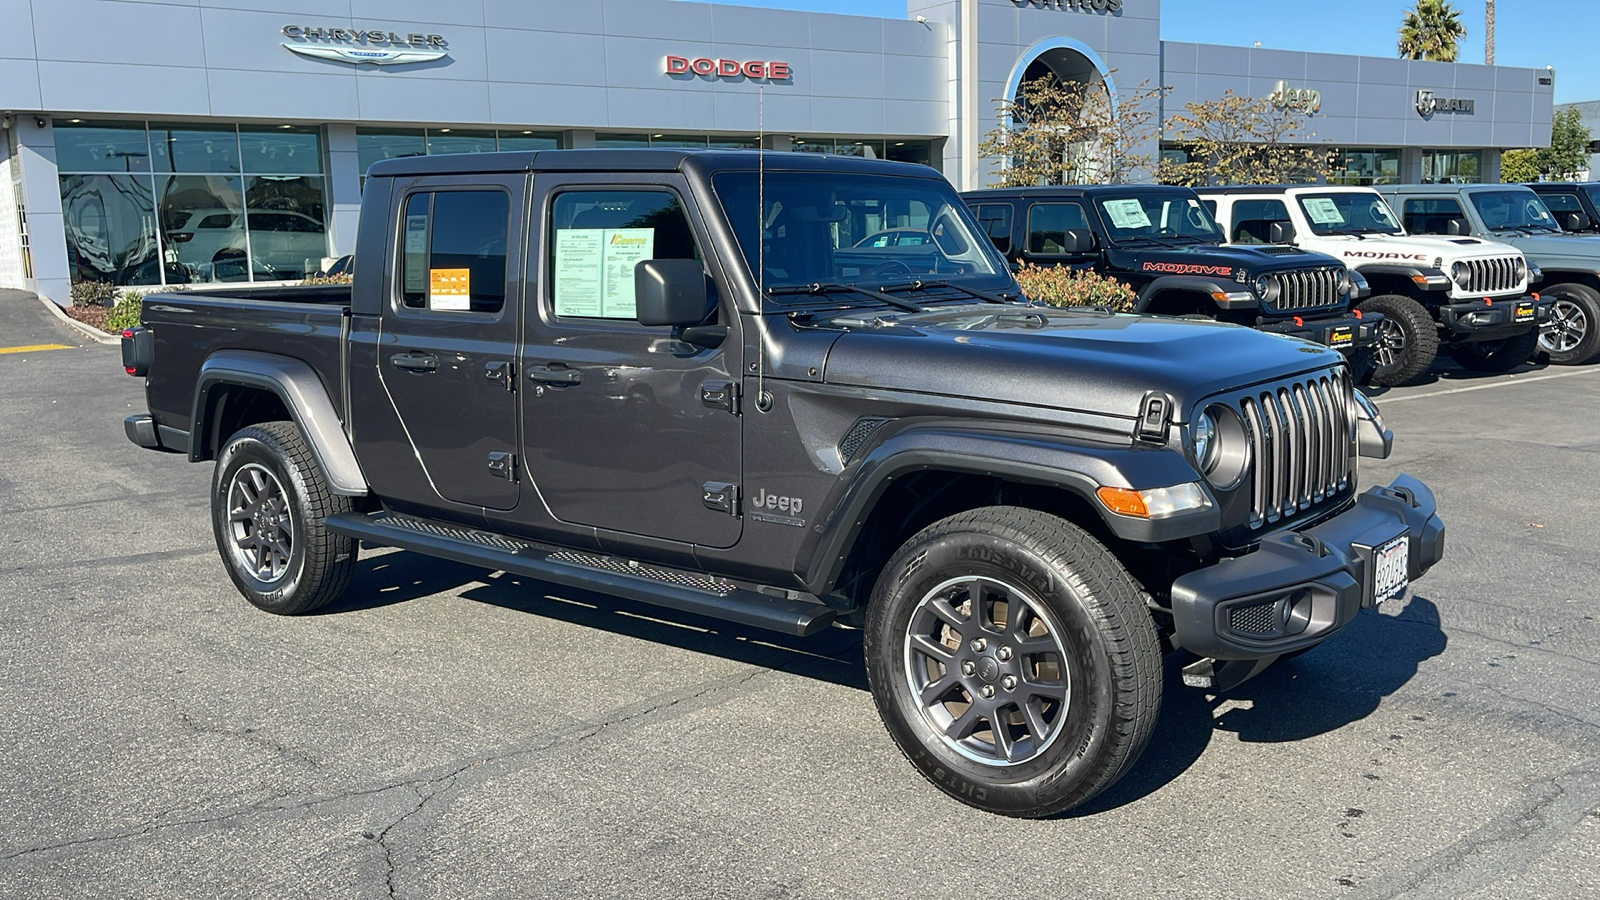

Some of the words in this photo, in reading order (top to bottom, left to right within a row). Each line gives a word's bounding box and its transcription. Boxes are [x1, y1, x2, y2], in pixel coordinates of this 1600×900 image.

[283, 25, 445, 47] CHRYSLER
[664, 55, 790, 79] DODGE
[1268, 80, 1321, 114] Jeep
[1436, 99, 1474, 112] RAM
[1343, 250, 1427, 262] MOJAVE
[1142, 262, 1232, 276] MOJAVE
[752, 488, 803, 516] Jeep
